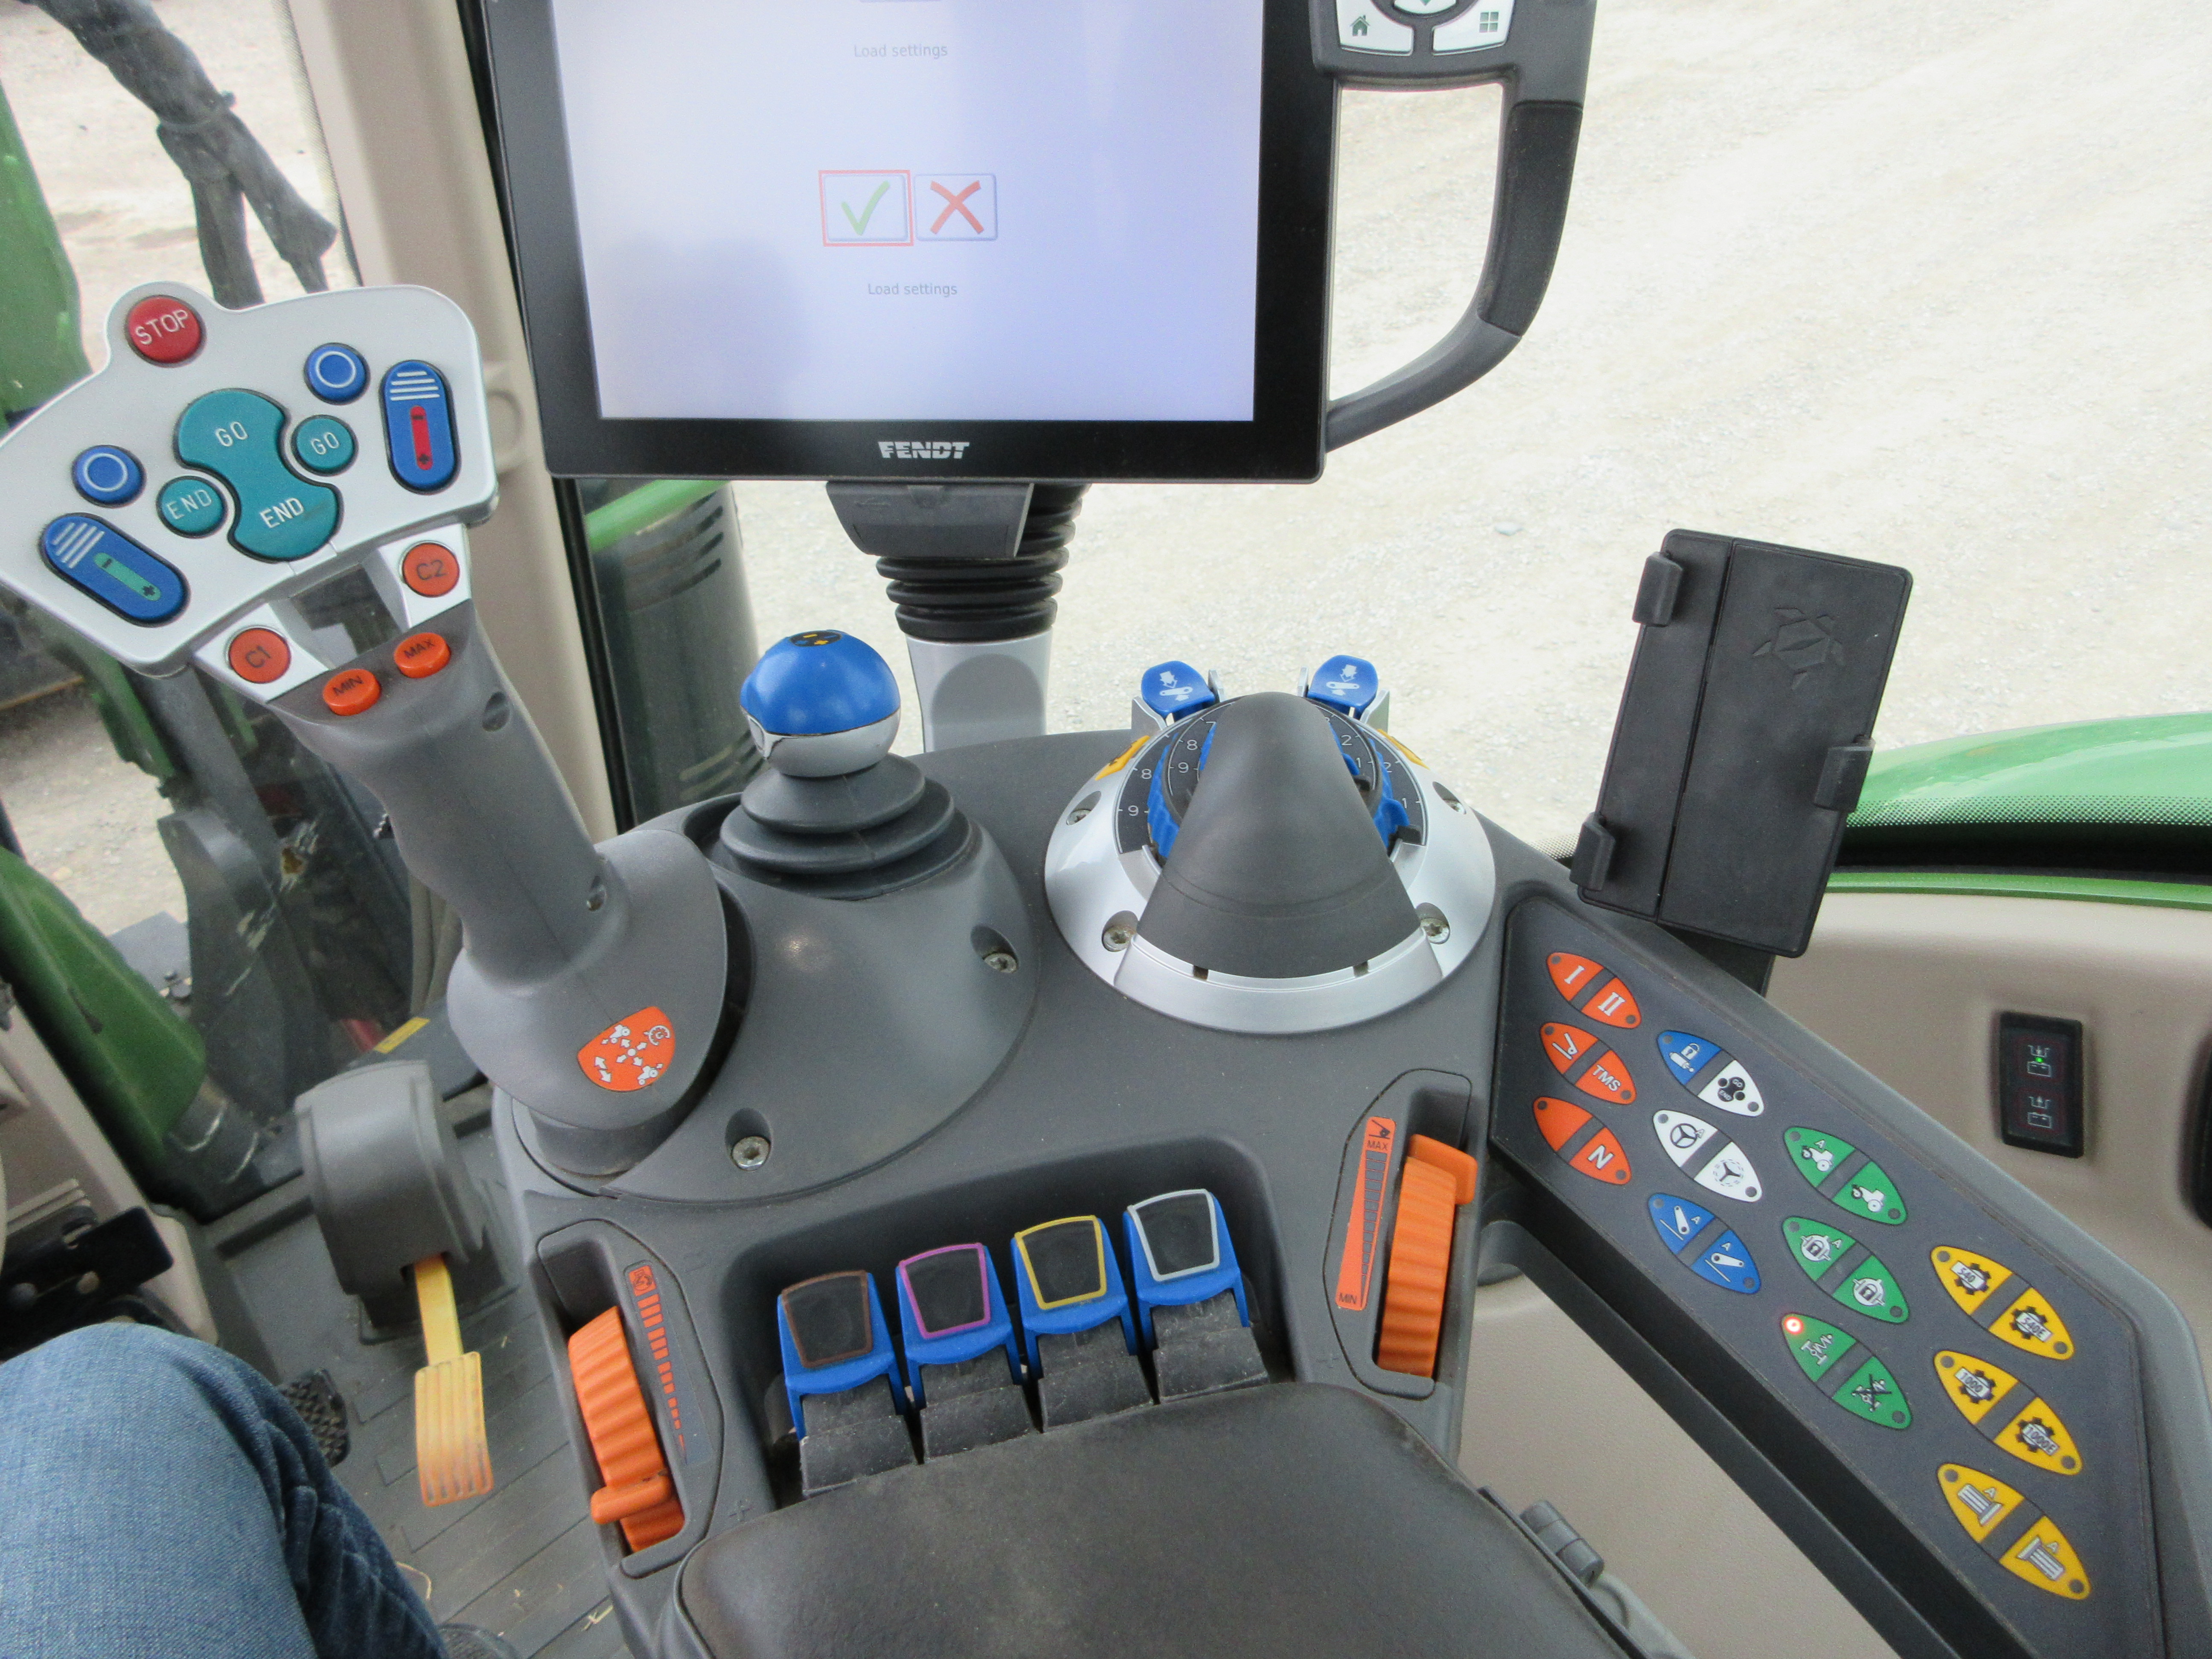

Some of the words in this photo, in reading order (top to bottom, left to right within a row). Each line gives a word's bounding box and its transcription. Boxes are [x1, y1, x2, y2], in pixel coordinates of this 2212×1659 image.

[854, 44, 887, 58] Load
[892, 44, 948, 60] settings
[868, 283, 899, 295] Load
[904, 283, 958, 298] settings
[135, 309, 189, 345] STOP
[215, 421, 249, 447] GO
[310, 431, 341, 455] GO
[877, 441, 970, 459] FENDT
[165, 489, 213, 520] END
[259, 497, 305, 529] END
[416, 559, 448, 581] C2
[245, 645, 273, 669] C1
[403, 639, 435, 660] MAX
[332, 674, 364, 697] MIN
[1187, 739, 1198, 751] 8
[1341, 735, 1353, 746] 2
[1178, 762, 1189, 773] 9
[1355, 757, 1361, 768] 1
[1141, 768, 1152, 780] 8
[1128, 805, 1139, 816] 9
[1402, 797, 1407, 809] 1
[1592, 1064, 1621, 1092] TMS
[1367, 1139, 1389, 1151] MAX
[1815, 1139, 1827, 1149] A
[1587, 1145, 1614, 1170] N
[1691, 1215, 1702, 1225] A
[1721, 1242, 1732, 1252] A
[1832, 1239, 1843, 1249] A
[1957, 1267, 1976, 1283] 540
[1339, 1292, 1358, 1305] MIN
[2020, 1317, 2046, 1338] 540E
[1960, 1372, 1983, 1392] 1000
[2026, 1426, 2056, 1453] 1000E
[1984, 1487, 1997, 1499] A
[2046, 1541, 2059, 1554] A
